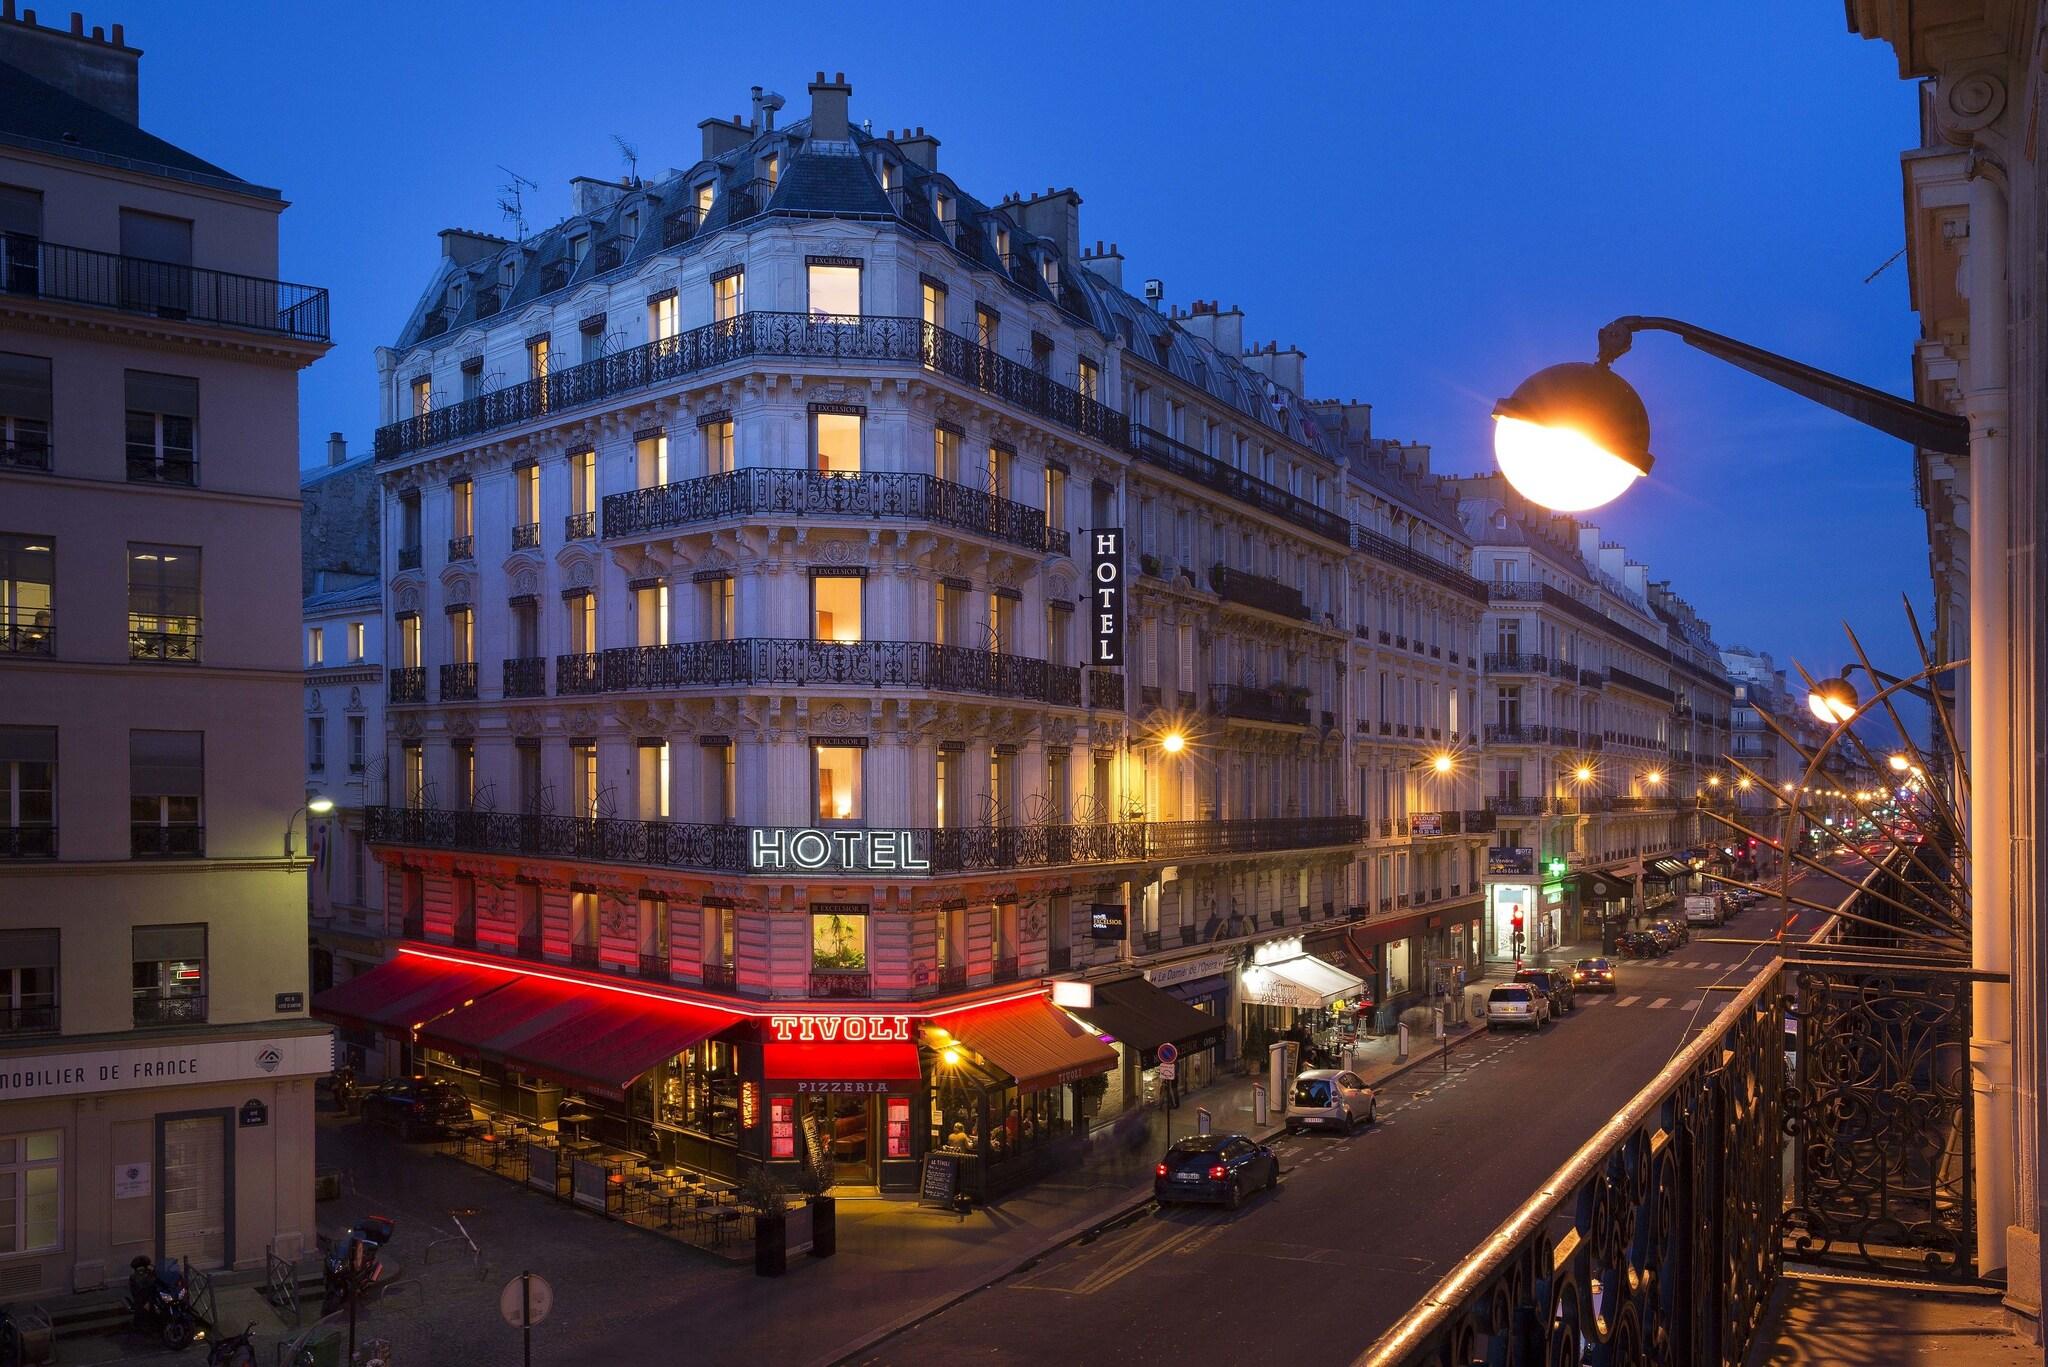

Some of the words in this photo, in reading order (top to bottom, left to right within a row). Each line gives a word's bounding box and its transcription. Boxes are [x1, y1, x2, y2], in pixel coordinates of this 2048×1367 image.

[814, 256, 854, 266] EXCELSIOR
[817, 405, 857, 414] EXCELSIOR
[818, 566, 859, 576] EXCELSIOR
[1096, 534, 1117, 660] HOTEL
[818, 736, 859, 746] EXCELSIOR
[752, 829, 930, 869] HOTEL
[819, 903, 860, 913] EXCELSIOR
[1262, 993, 1299, 1005] BISTROT
[771, 1016, 909, 1041] TIVOLI
[100, 1065, 119, 1081] DE
[134, 1058, 197, 1078] FRANCE
[797, 1082, 889, 1093] PIZZERIA
